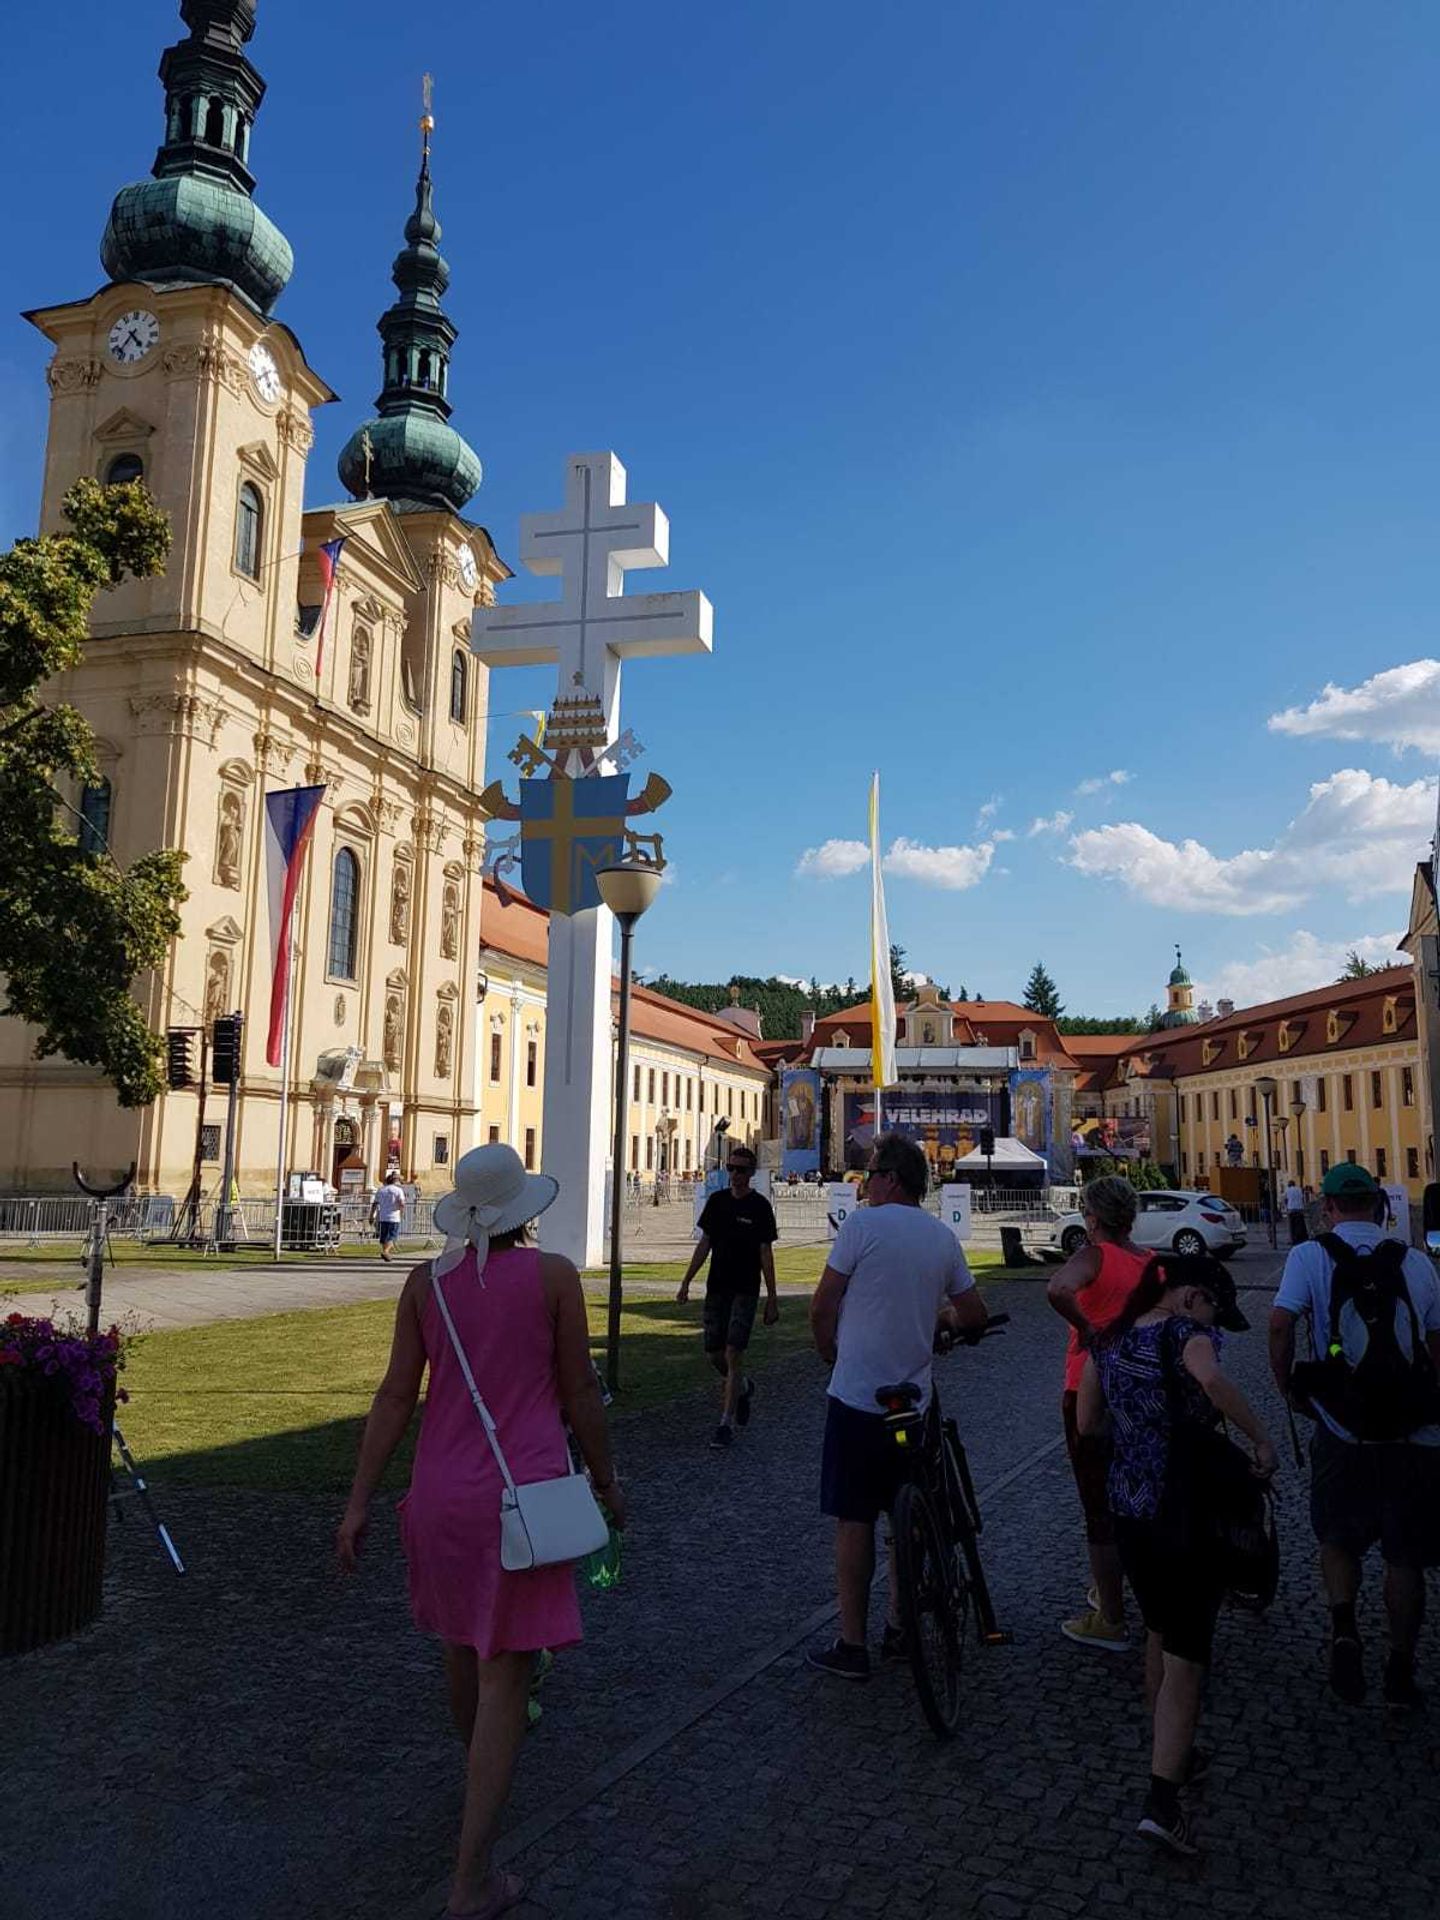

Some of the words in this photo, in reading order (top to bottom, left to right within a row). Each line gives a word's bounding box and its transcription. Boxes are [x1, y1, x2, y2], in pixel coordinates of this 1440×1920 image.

[885, 1108, 988, 1123] VELEHRAD
[838, 1209, 847, 1221] D
[953, 1211, 961, 1223] D
